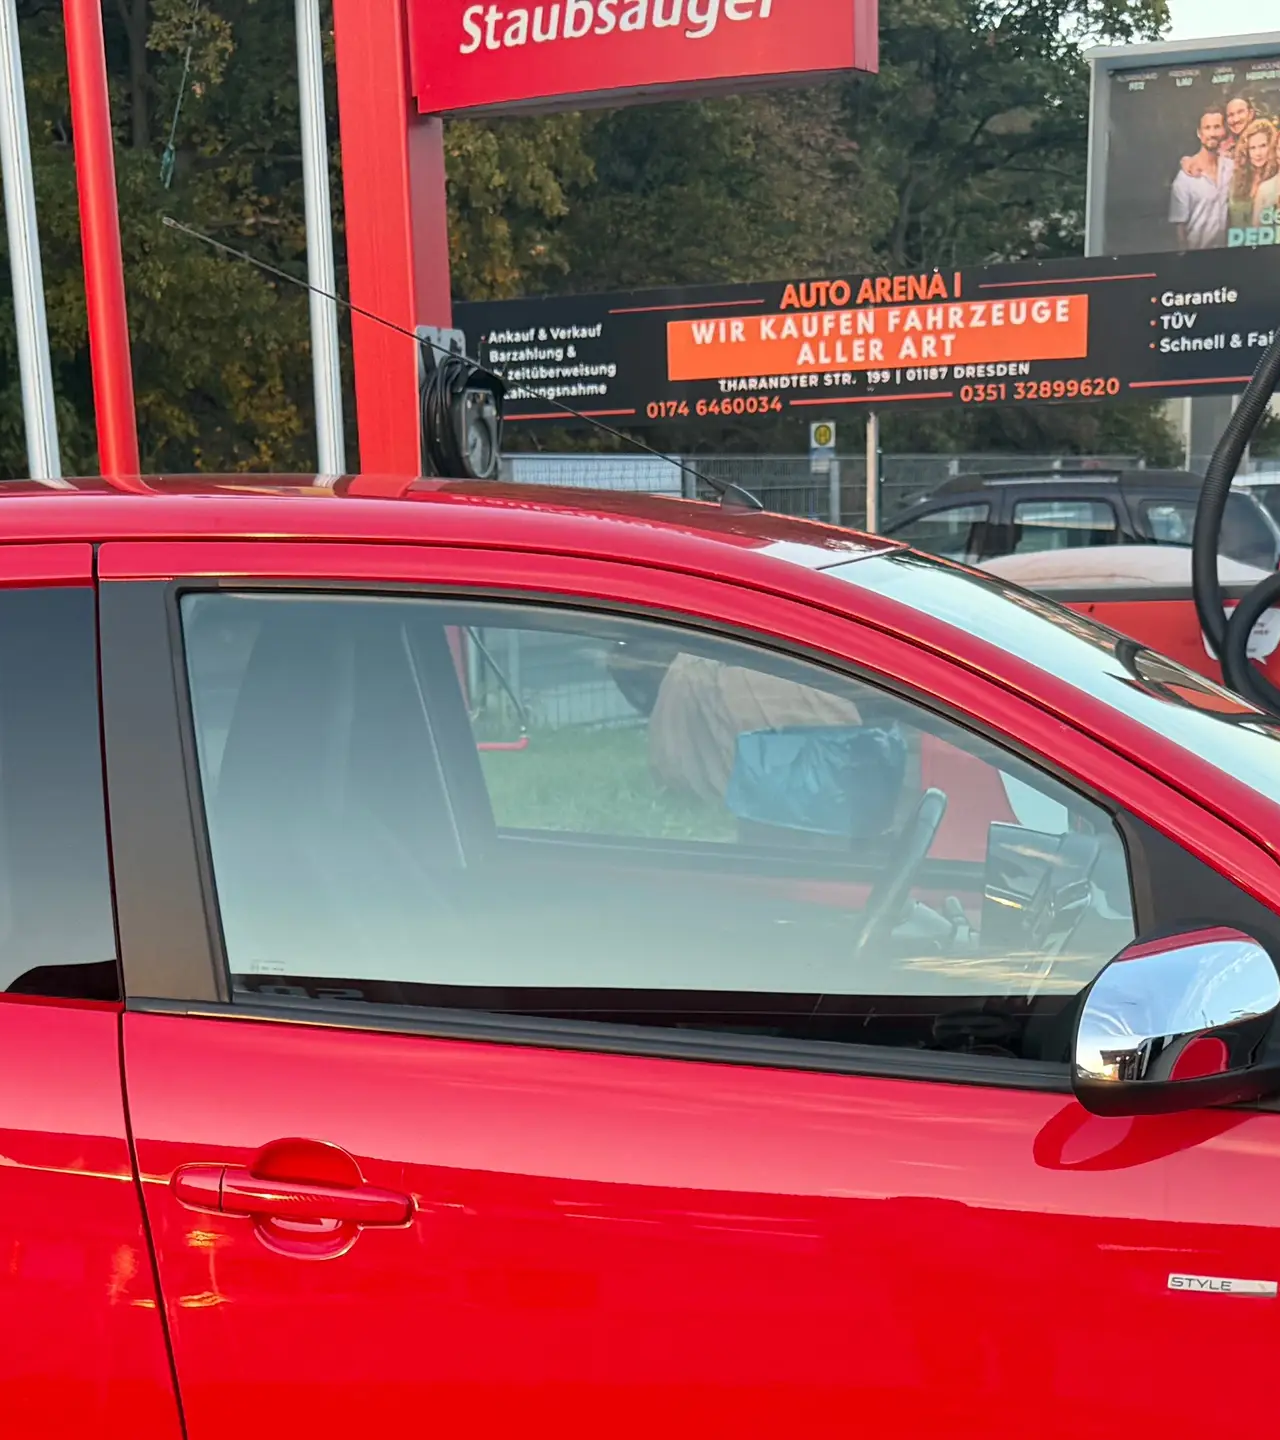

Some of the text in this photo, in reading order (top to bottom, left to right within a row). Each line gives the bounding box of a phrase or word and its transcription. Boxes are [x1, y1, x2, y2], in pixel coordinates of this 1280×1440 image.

[780, 279, 851, 310] AUTO
[856, 273, 948, 304] ARENA
[1160, 287, 1239, 308] Garantie
[488, 322, 603, 344] Ankauf & Verkauf
[691, 299, 1071, 345] WIR KAUFEN FAHRZEUGE
[1160, 311, 1197, 331] TÜV
[489, 344, 577, 363] Barzahlung &
[796, 333, 957, 366] ALLER ART
[1159, 330, 1275, 354] Schnell & Fai
[718, 373, 819, 393] THARANDTER
[823, 372, 857, 387] STR.
[866, 370, 891, 384] 199
[906, 366, 949, 382] 01187
[953, 361, 1031, 379] DRESDEN
[959, 377, 1121, 402] 0351 32899620
[646, 395, 782, 419] 0174 6460034
[1170, 1276, 1233, 1292] STYLE
